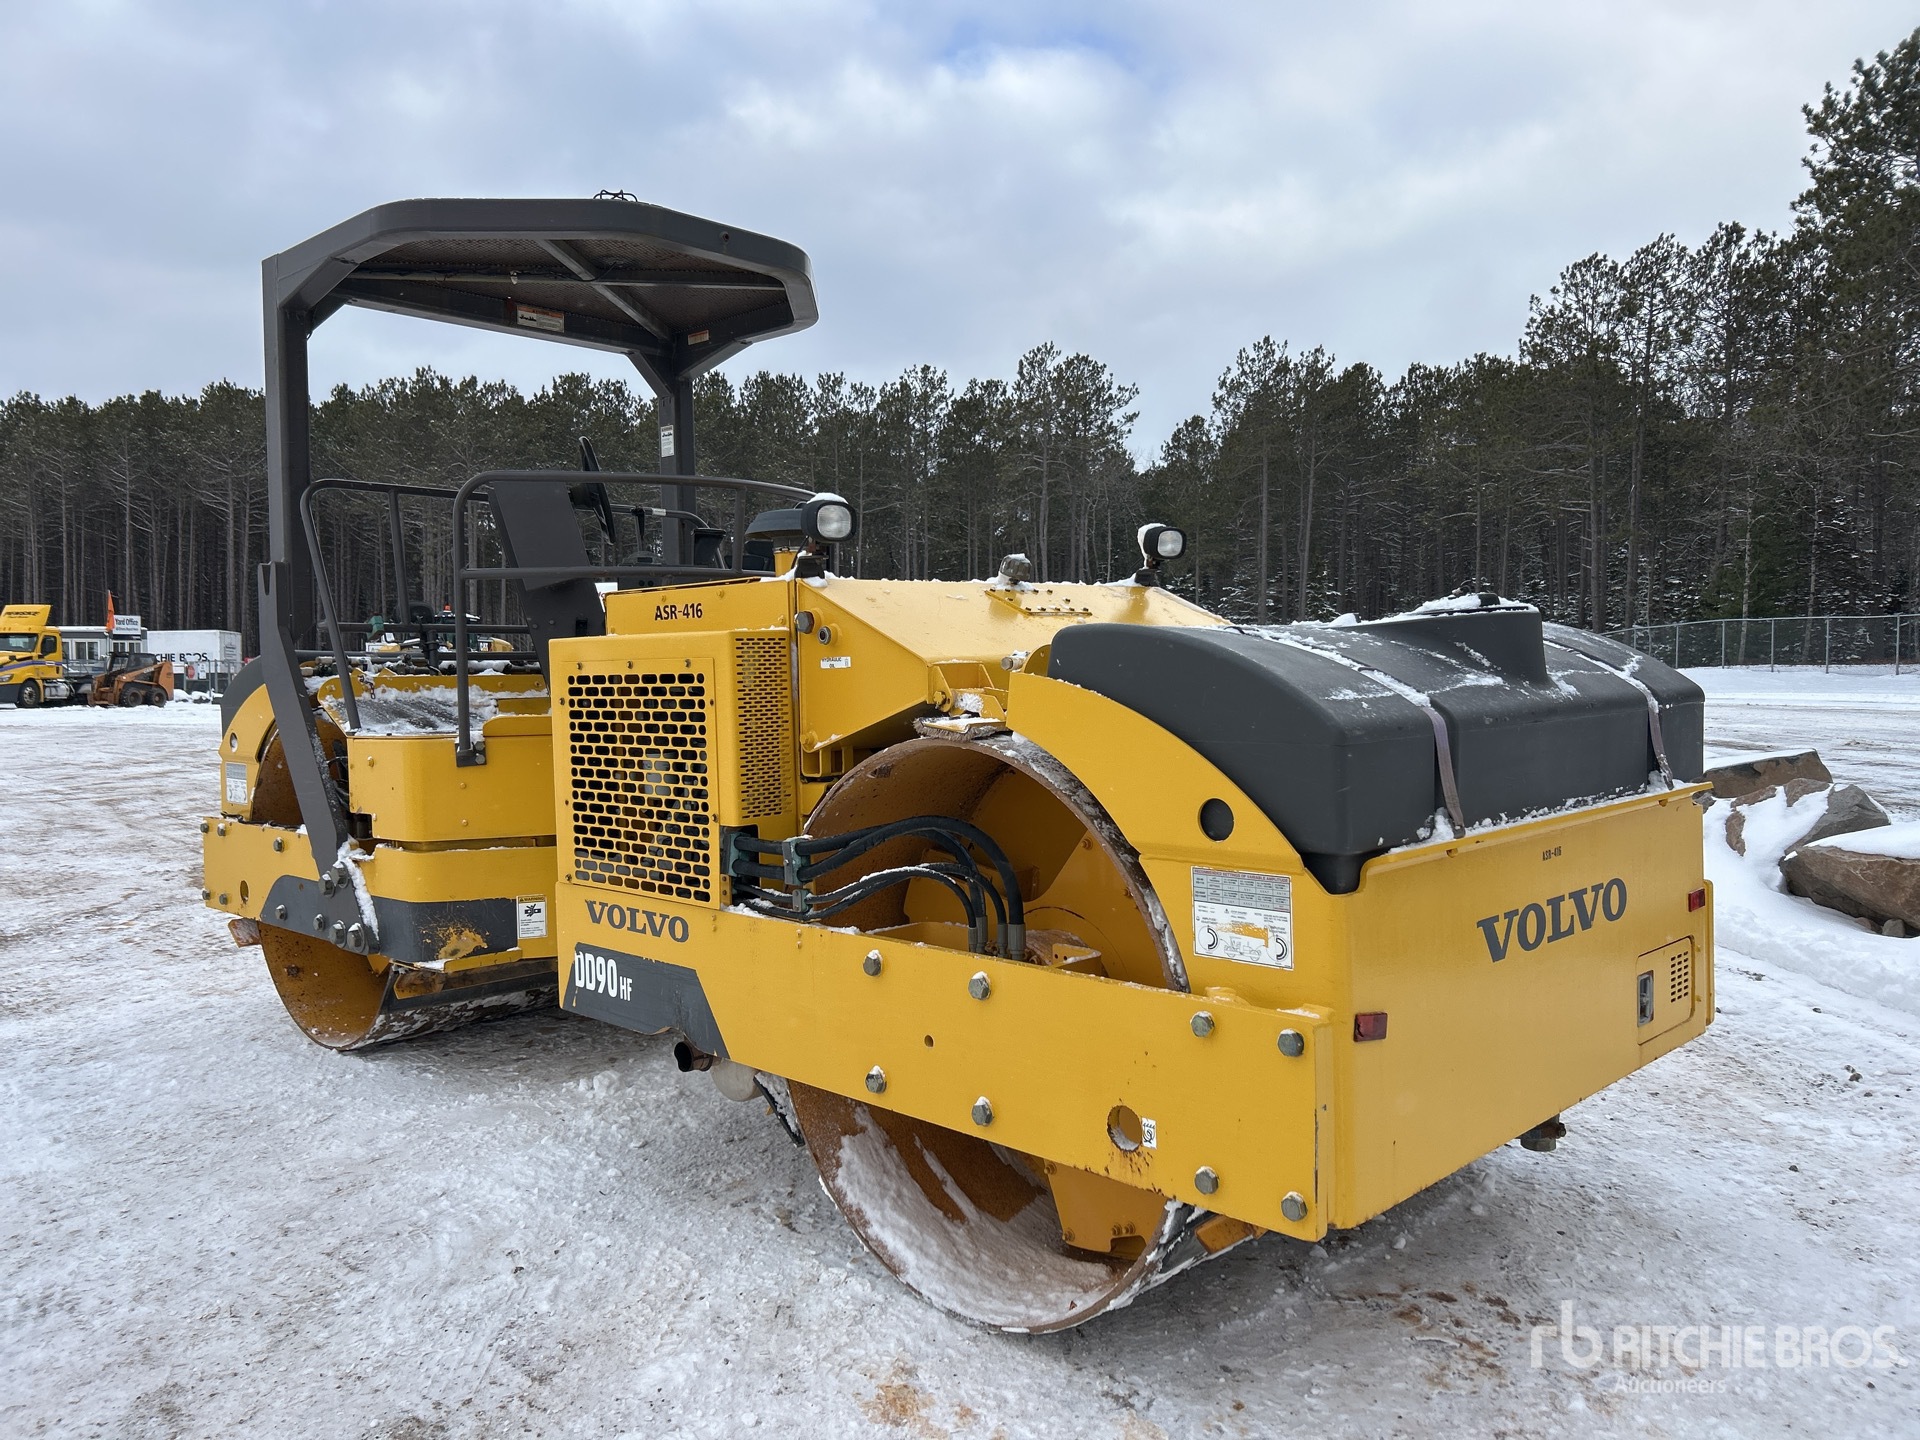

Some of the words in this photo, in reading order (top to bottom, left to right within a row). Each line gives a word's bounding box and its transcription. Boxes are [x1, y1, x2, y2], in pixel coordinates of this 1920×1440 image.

[655, 603, 703, 621] ASR-416
[115, 618, 125, 626] Yard
[126, 618, 138, 626] Office
[155, 653, 176, 662] CHIE
[1542, 845, 1562, 861] ASR-416
[585, 899, 689, 943] VOLVO
[1476, 878, 1627, 963] VOLVO
[574, 951, 617, 998] DD90
[619, 976, 633, 1001] HF
